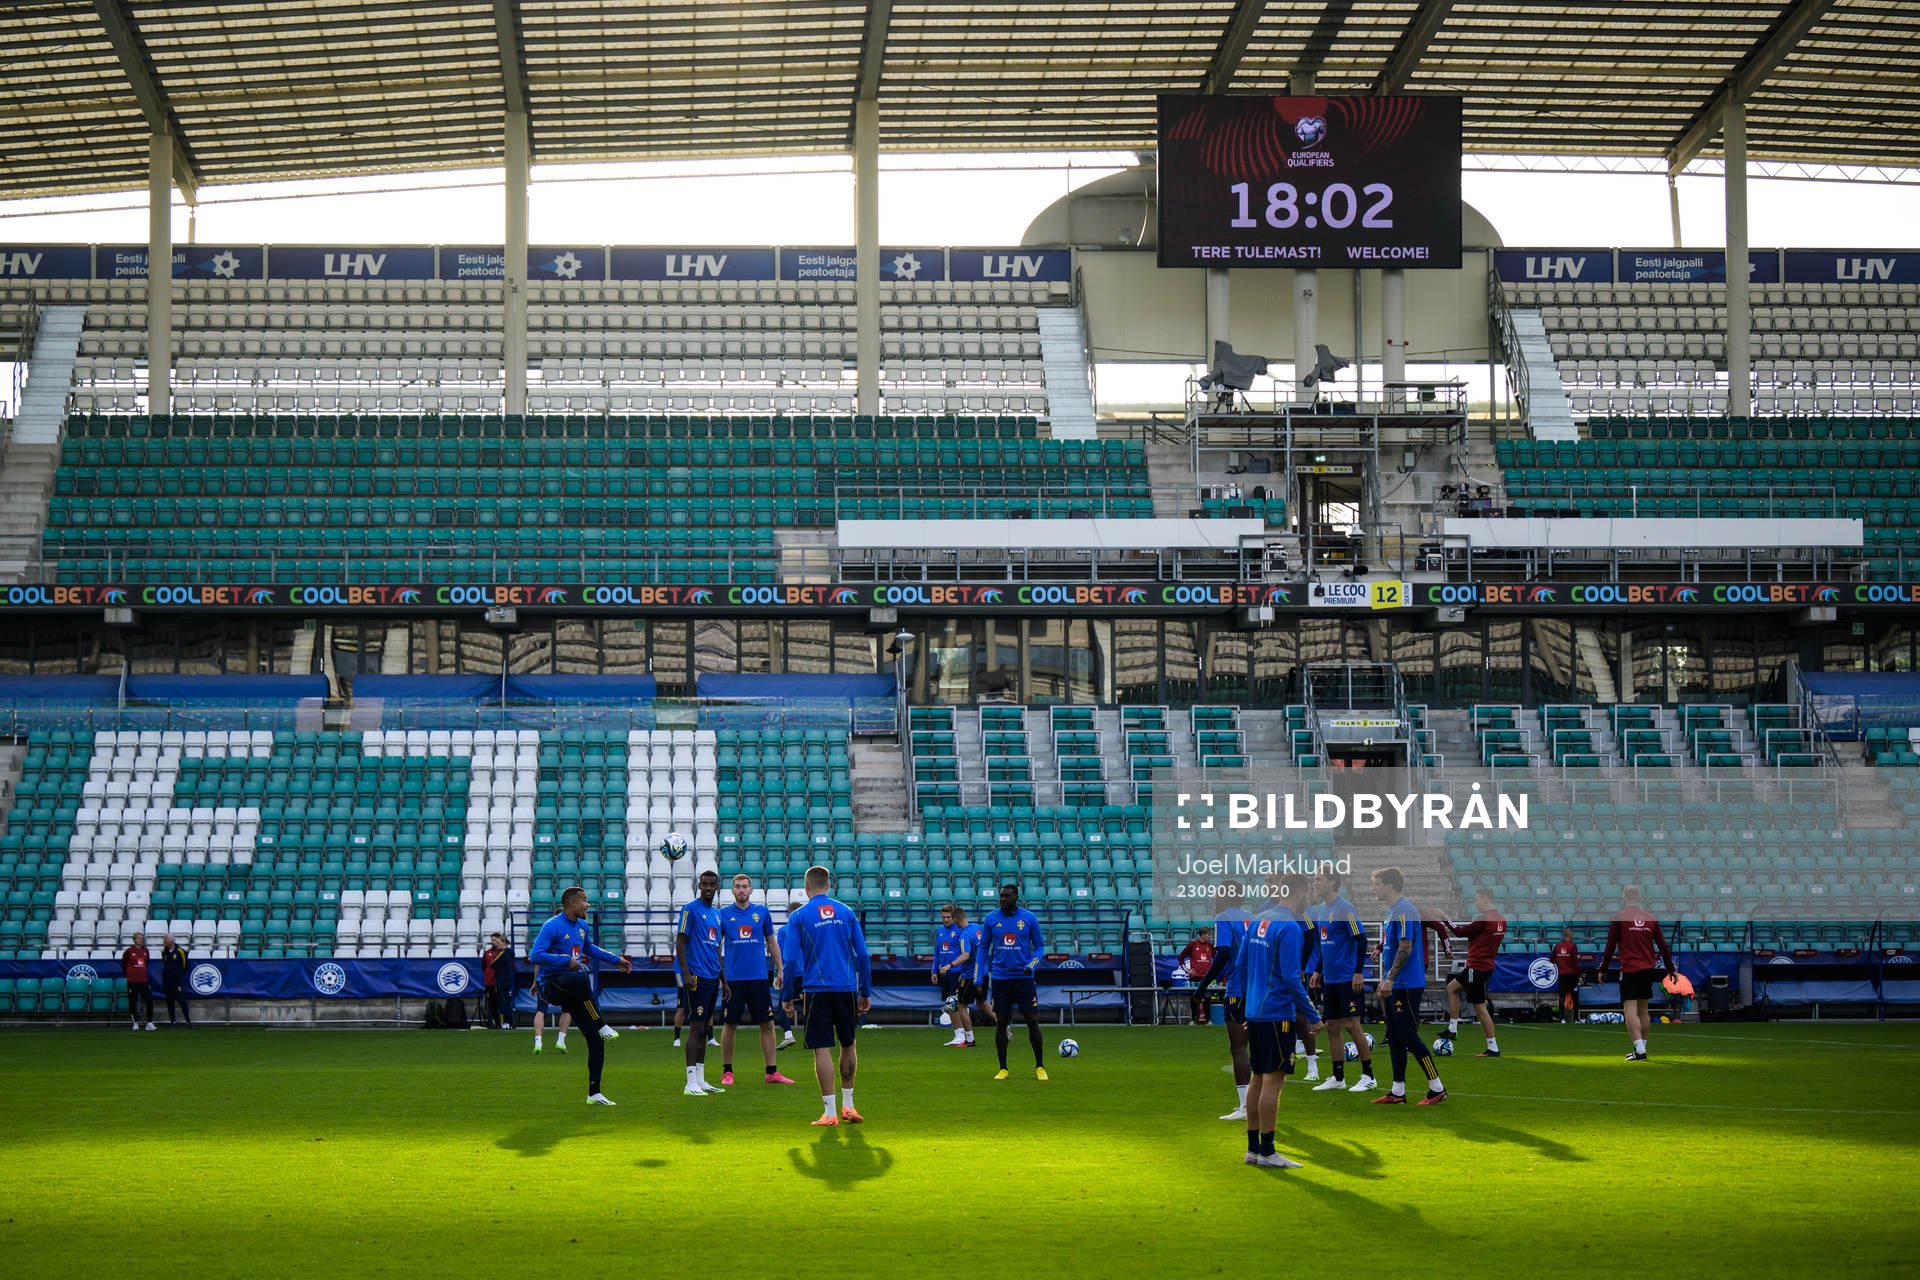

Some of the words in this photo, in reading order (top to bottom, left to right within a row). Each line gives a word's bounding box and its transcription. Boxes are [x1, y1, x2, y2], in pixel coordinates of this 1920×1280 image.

[1287, 159, 1335, 168] QUALIFIERS
[1291, 151, 1330, 159] EUROPEAN
[1230, 182, 1394, 229] 18:02
[115, 253, 143, 263] Eesti
[458, 254, 485, 264] Eesti
[798, 255, 825, 265] Eesti
[1191, 246, 1231, 258] TERE
[1234, 246, 1321, 259] TULEMAST!
[1346, 246, 1429, 259] WELCOME!
[0, 252, 43, 275] HV
[324, 253, 387, 276] LHV
[458, 266, 505, 277] peatoeta
[665, 254, 728, 277] LHV
[982, 255, 1045, 278] LHV
[1525, 256, 1586, 279] LHV
[1635, 257, 1661, 267] Eesti
[1663, 257, 1704, 269] jalgpalli
[1836, 258, 1896, 280] LHV
[798, 267, 855, 278] peatoetaja
[1635, 269, 1691, 280] peatoetaja
[142, 586, 242, 604] COOLBET
[289, 586, 389, 604] COOLBET
[436, 586, 536, 604] COOLBET
[582, 586, 682, 604] COOLBET
[728, 586, 827, 604] COOLBET
[873, 586, 972, 604] COOLBET
[1017, 586, 1116, 604] COOLBET
[1161, 586, 1260, 604] COOLBET
[1328, 584, 1341, 596] LE
[1344, 584, 1366, 598] COQ
[1376, 586, 1398, 603] 12
[1428, 585, 1525, 603] COOLBET
[1571, 585, 1668, 603] COOLBET
[1713, 585, 1809, 603] COOLBET
[1855, 585, 1920, 603] COOLB
[1323, 597, 1357, 605] PREMIUM
